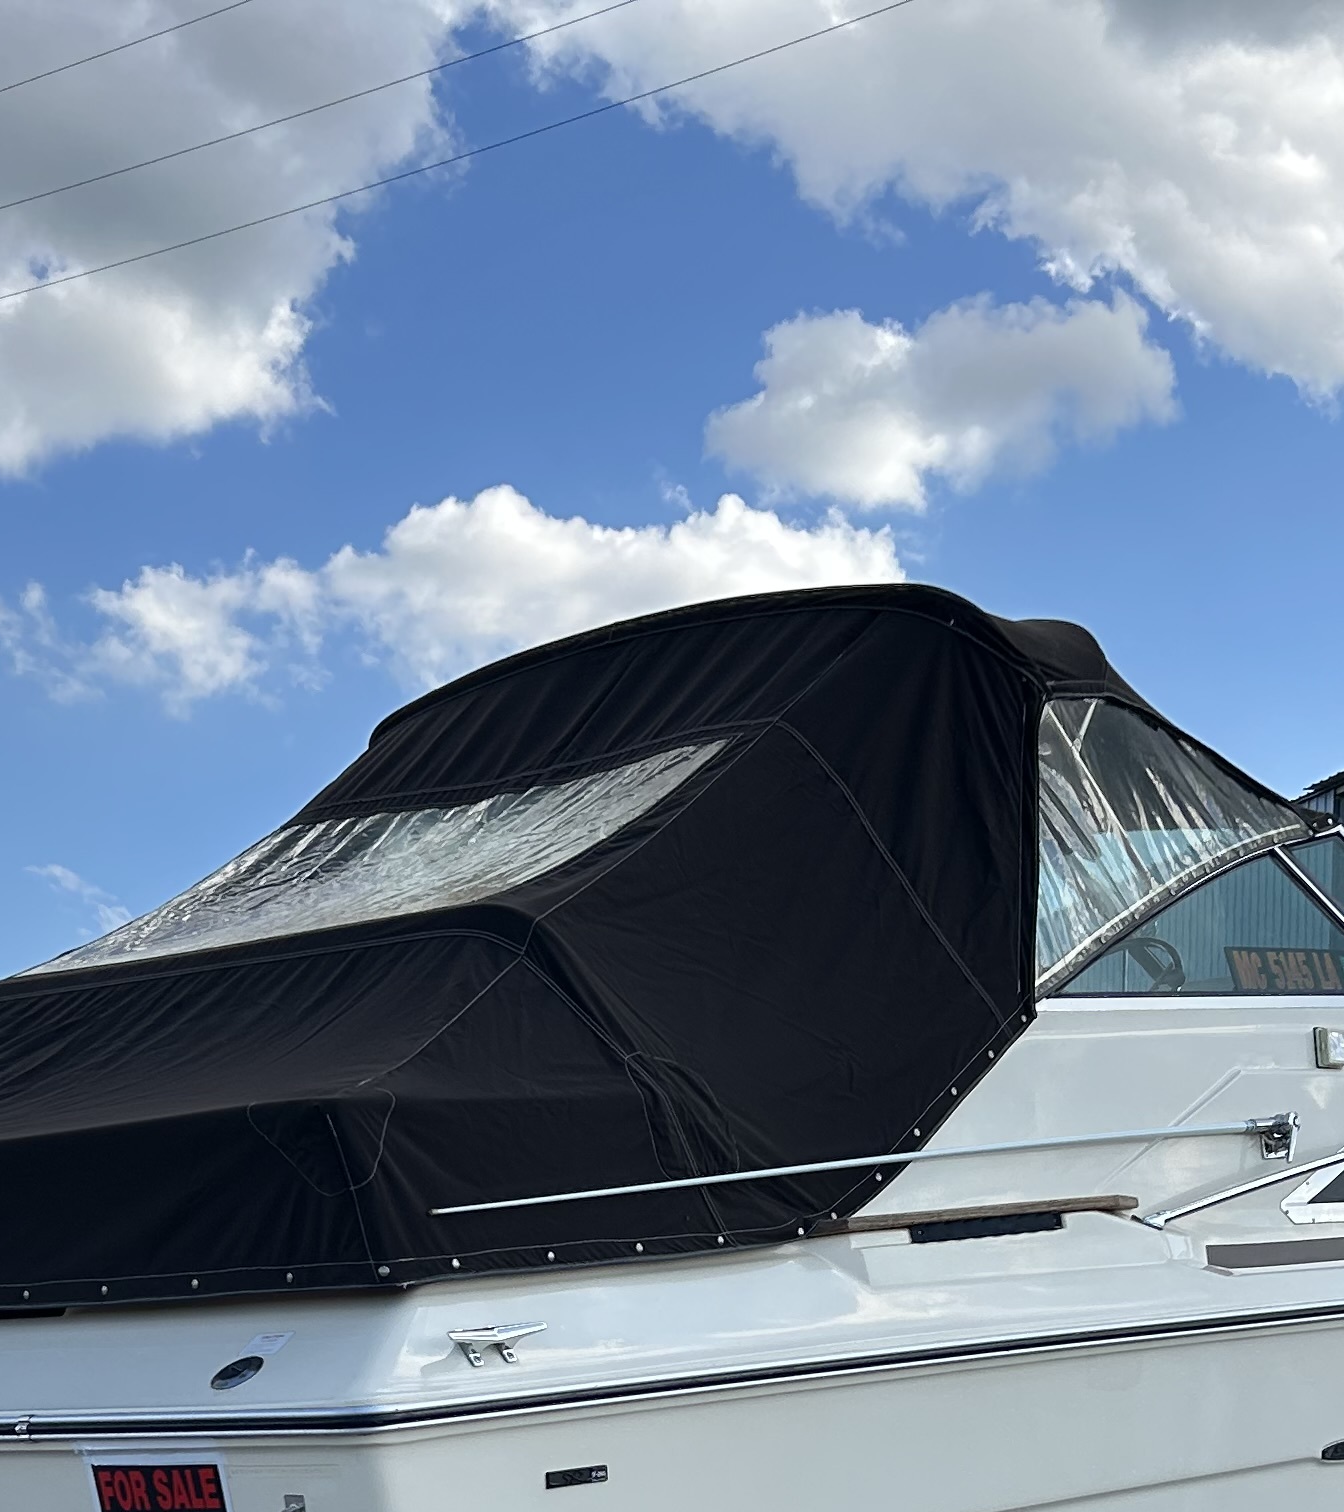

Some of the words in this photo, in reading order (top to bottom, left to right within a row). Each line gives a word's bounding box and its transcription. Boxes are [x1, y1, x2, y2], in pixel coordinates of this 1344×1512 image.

[1232, 950, 1268, 990] MC
[1266, 952, 1315, 990] 5145
[1311, 952, 1343, 990] LA
[97, 1470, 151, 1511] FOR
[152, 1468, 222, 1511] SALE
